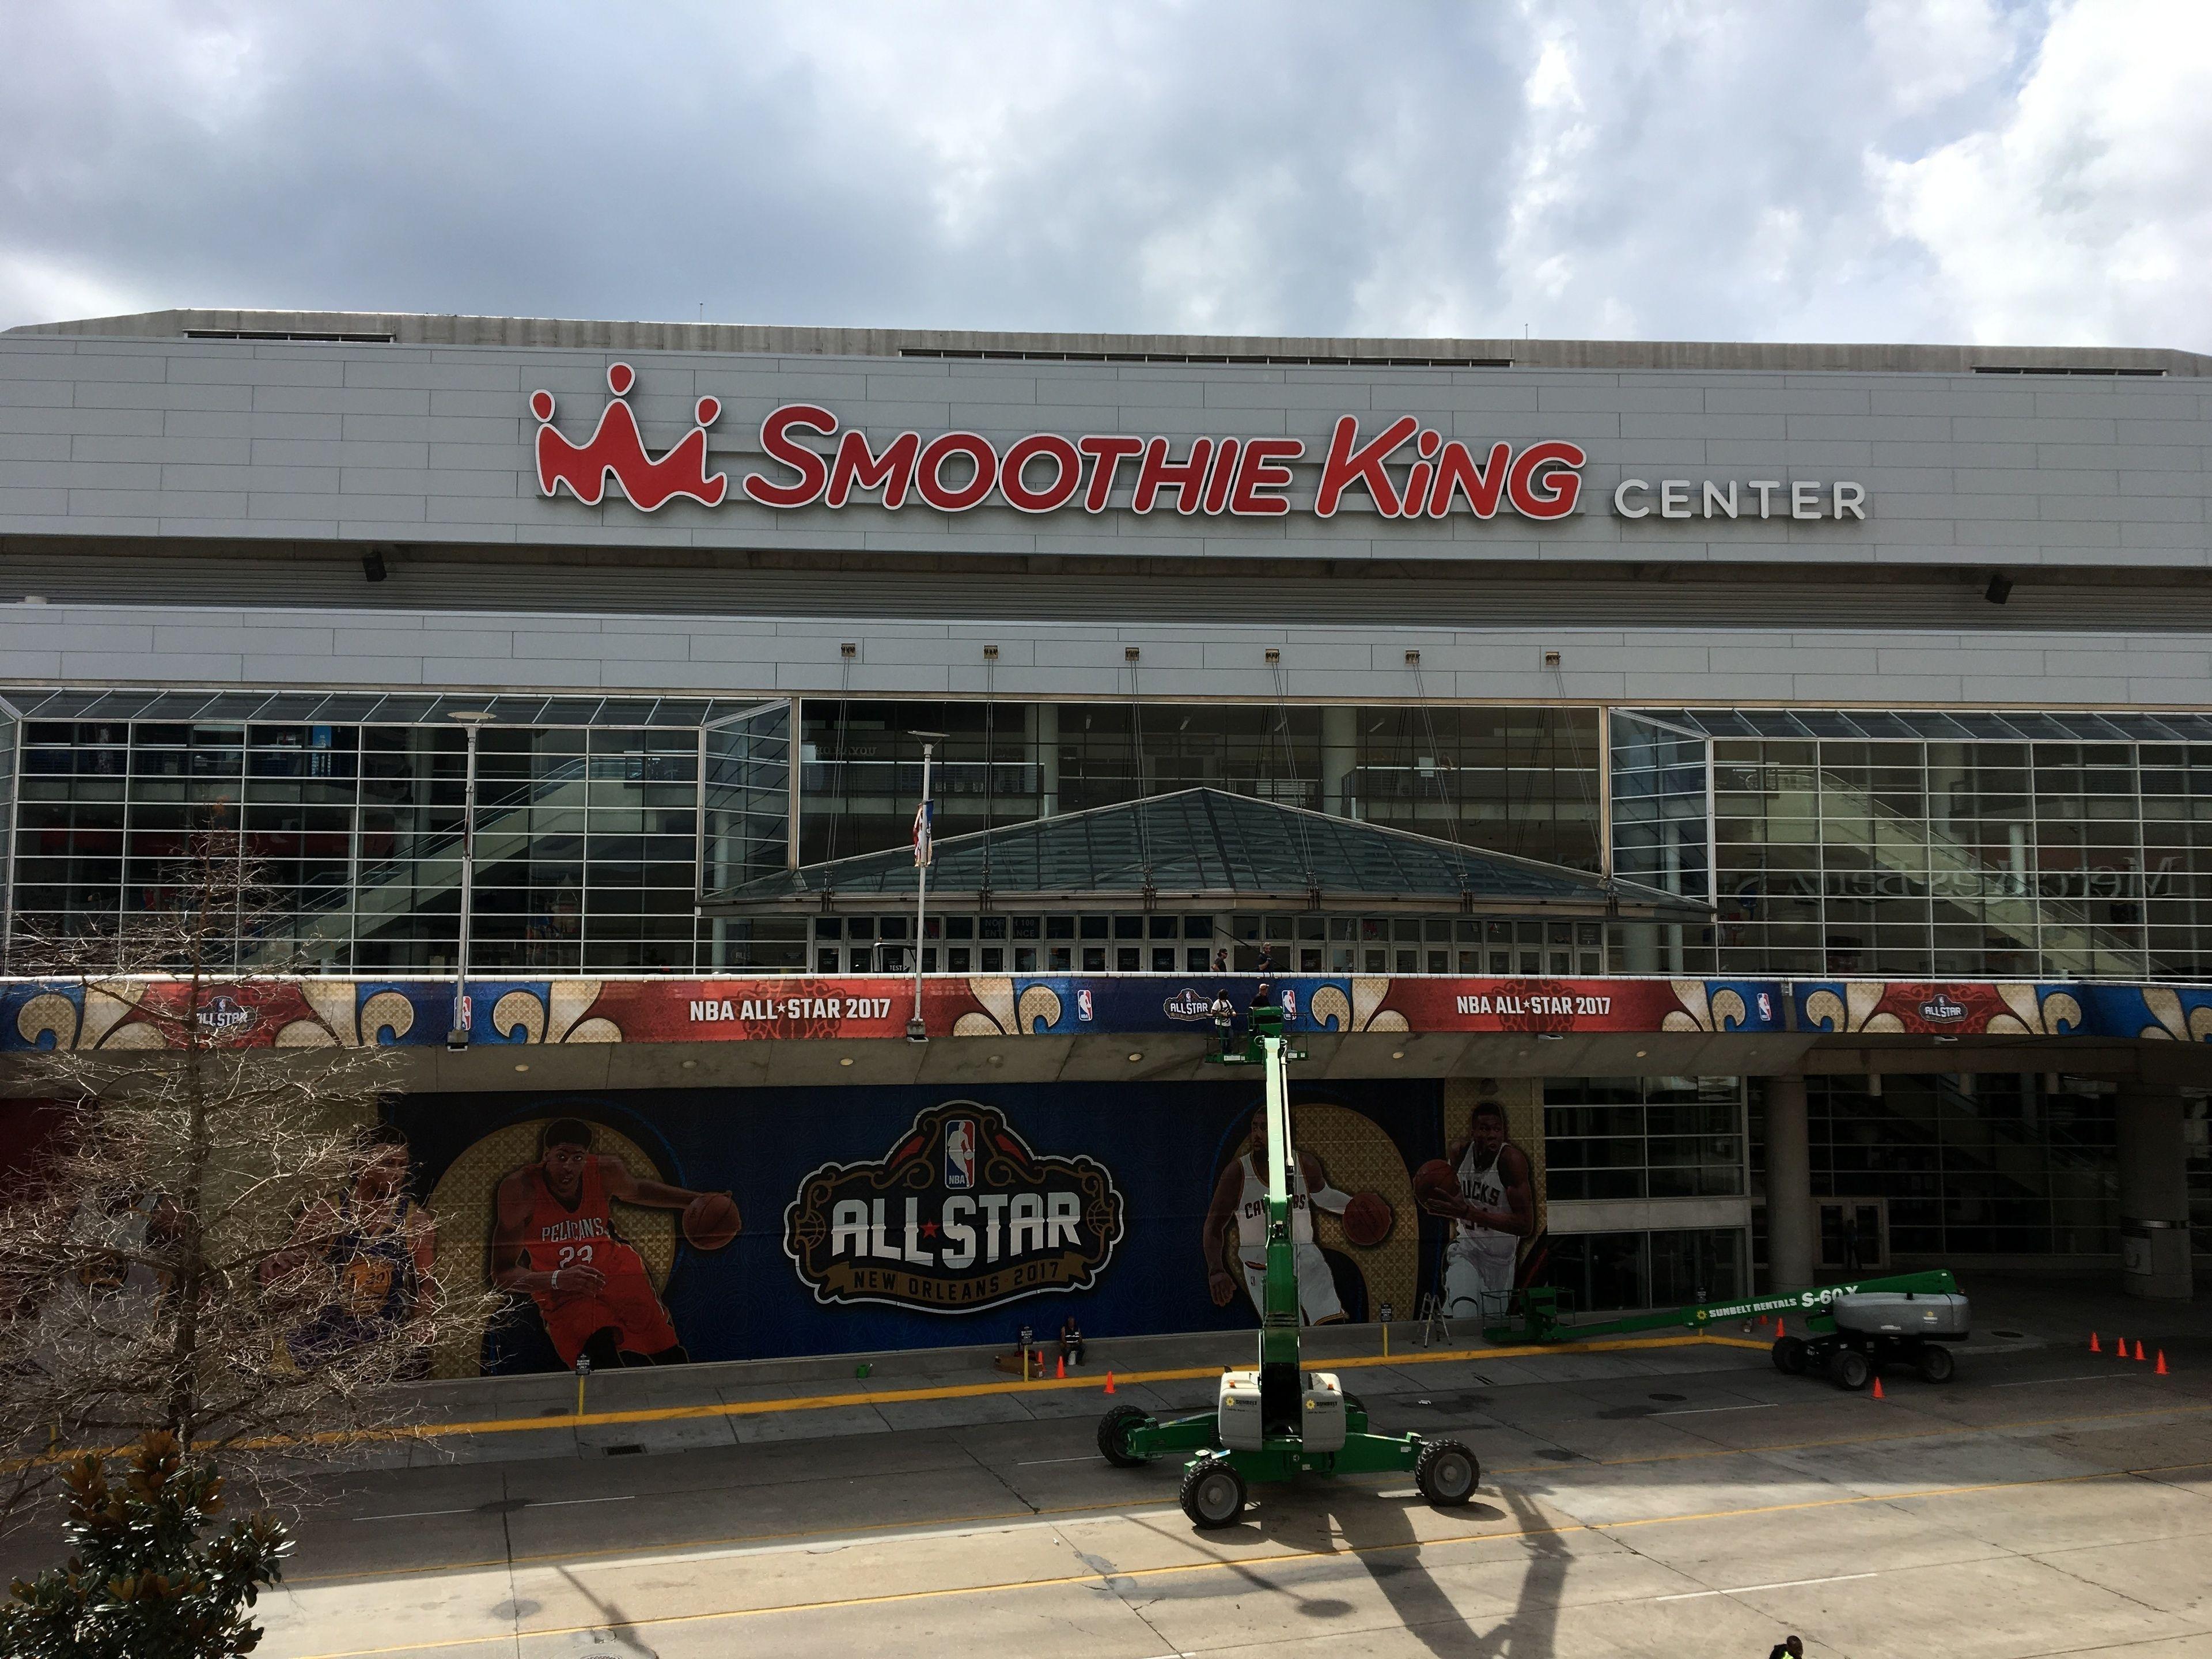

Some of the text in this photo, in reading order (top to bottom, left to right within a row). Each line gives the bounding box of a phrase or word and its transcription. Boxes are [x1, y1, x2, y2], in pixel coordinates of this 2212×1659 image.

[743, 403, 1306, 516] SMOOTHIE
[1615, 479, 1866, 520] CENTER
[984, 929, 1035, 937] ENTNCE
[985, 919, 1035, 927] NORH 100
[690, 998, 891, 1021] NBA ALL STAR 2017
[1170, 1002, 1209, 1015] ALL STAR
[1456, 995, 1611, 1015] NBA ALL STAR 2017
[1925, 1006, 1962, 1018] ALL STAR
[949, 1175, 965, 1184] NBA
[1463, 1180, 1501, 1206] UCKS
[541, 1217, 604, 1243] PELICANS
[831, 1192, 1081, 1269] ALL STAR
[854, 1262, 1059, 1301] NEW ORLEANS 2017
[1709, 1304, 1752, 1318] SUNBELT
[1753, 1298, 1797, 1312] RENTALS
